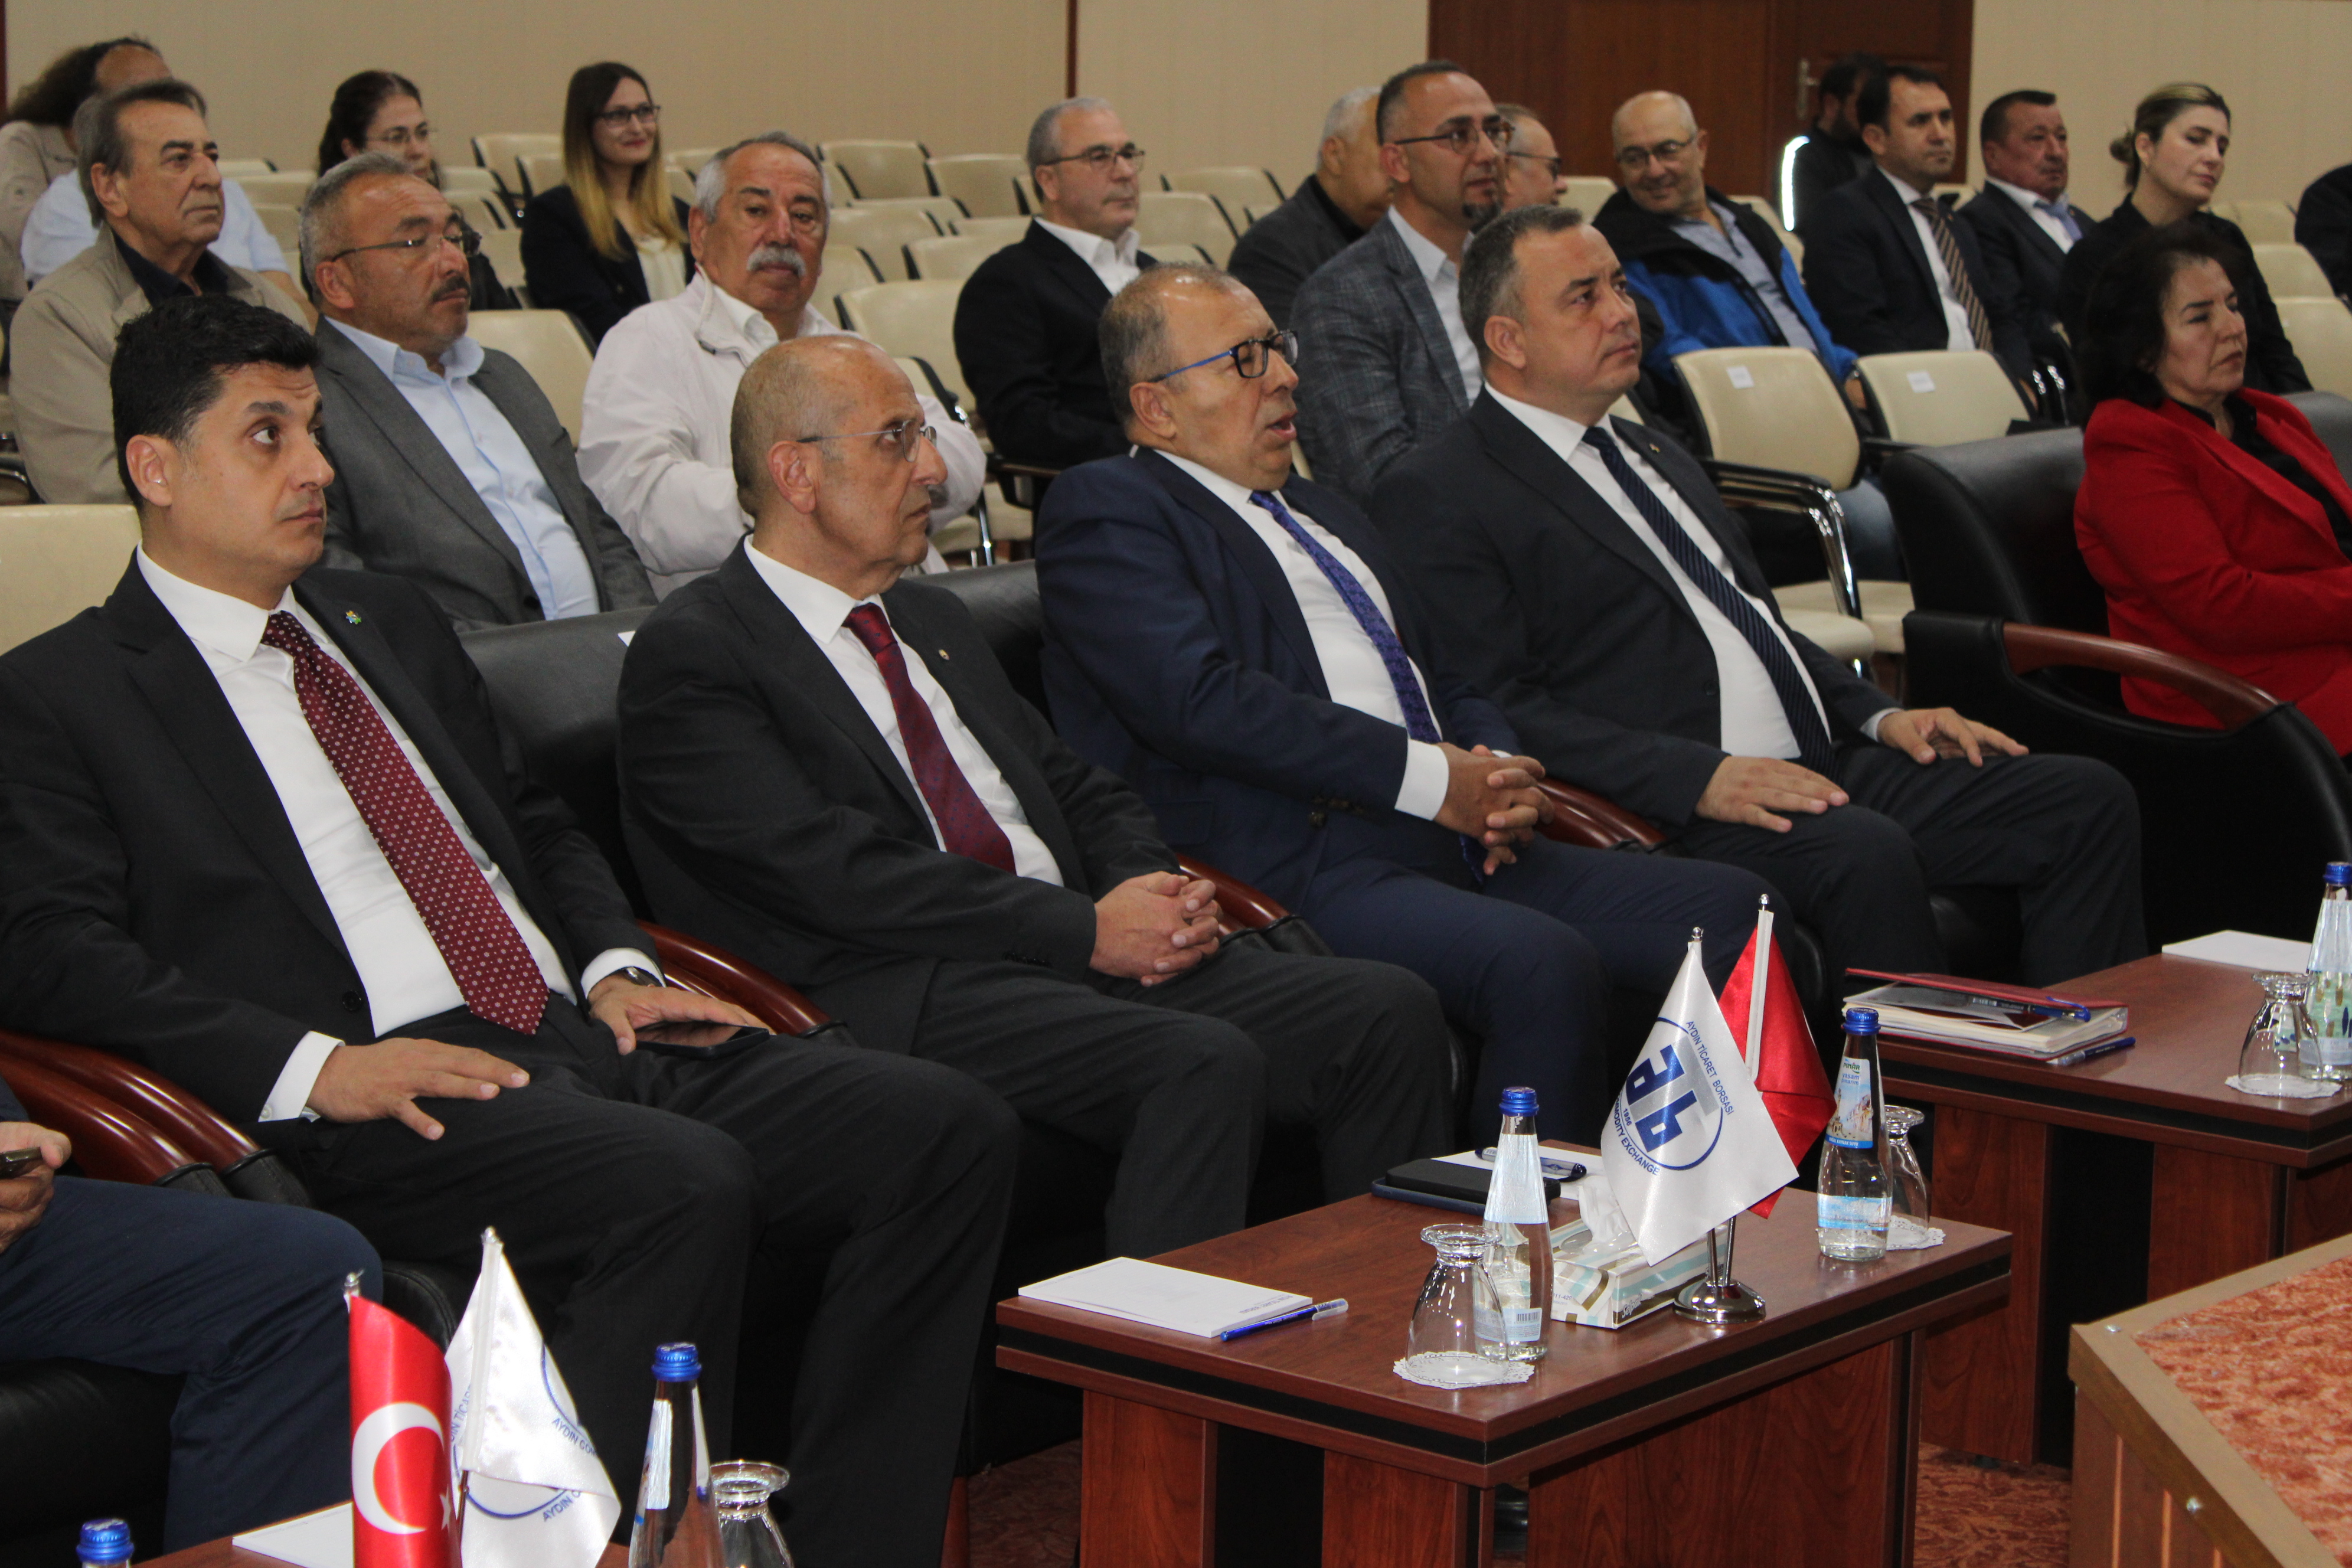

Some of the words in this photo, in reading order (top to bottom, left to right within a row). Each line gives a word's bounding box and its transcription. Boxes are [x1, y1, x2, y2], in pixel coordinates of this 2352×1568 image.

[1686, 1021, 1702, 1046] AYDIN
[1697, 1044, 1717, 1078] TİCARET
[1713, 1079, 1734, 1116] BORSASI
[1623, 1108, 1632, 1126] 1956
[1621, 1137, 1660, 1175] EXCHANGE
[552, 1417, 579, 1446] AYDIN
[543, 1495, 573, 1523] AYDIN
